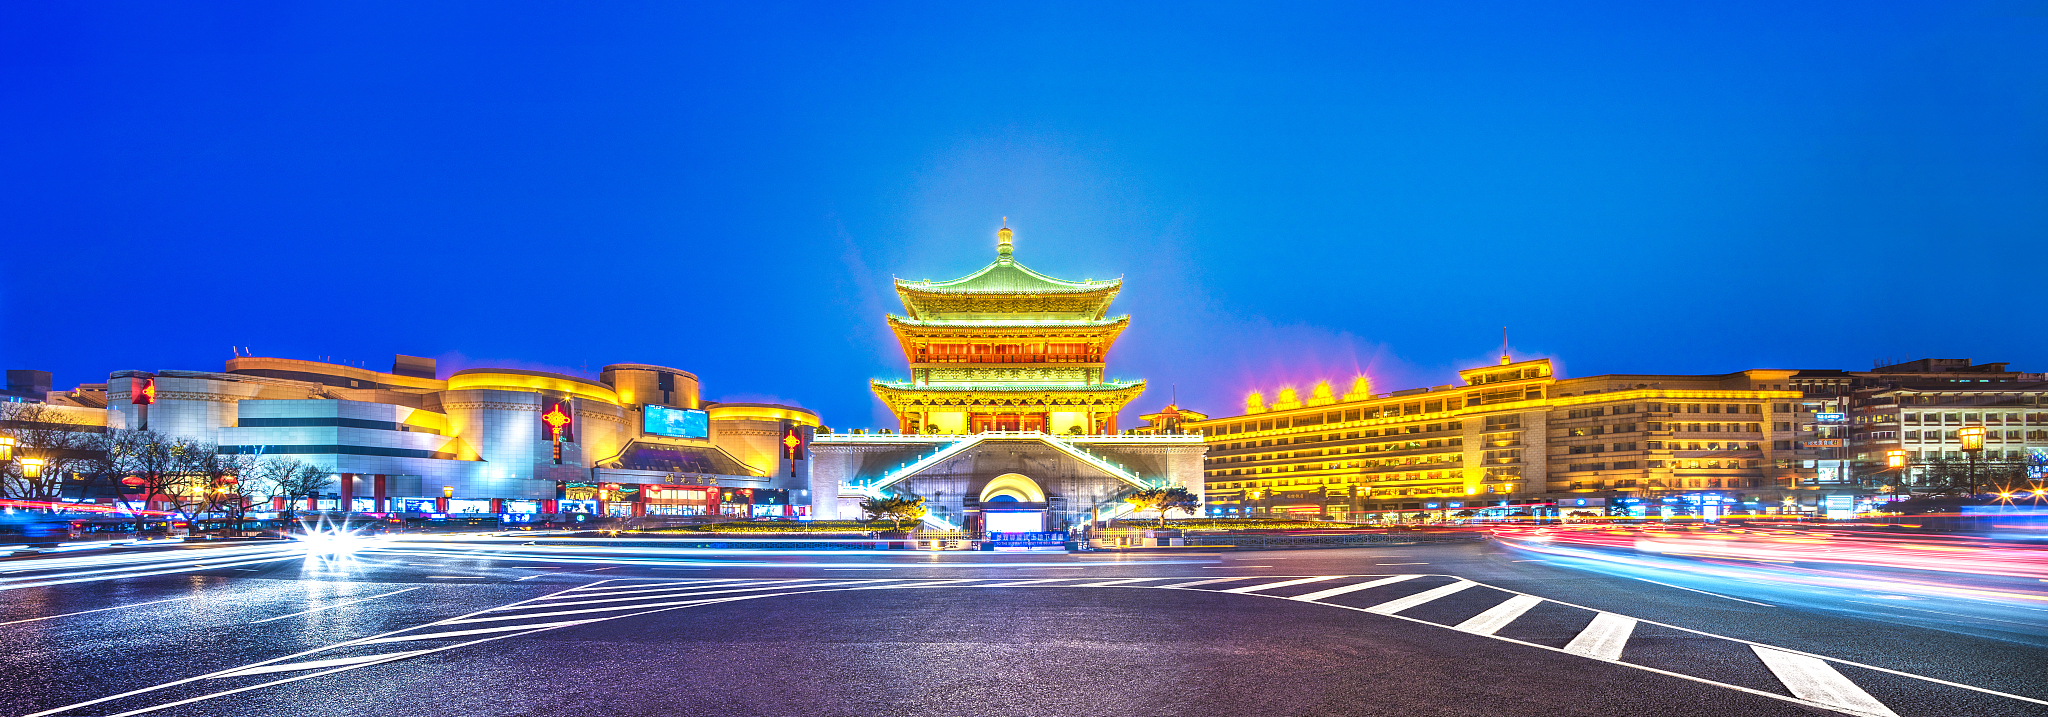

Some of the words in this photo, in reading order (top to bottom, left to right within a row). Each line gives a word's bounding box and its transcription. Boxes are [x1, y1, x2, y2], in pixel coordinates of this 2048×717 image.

[1273, 401, 1300, 411] TOWER
[1308, 396, 1335, 407] HOTEL
[1343, 392, 1367, 402] XIAN
